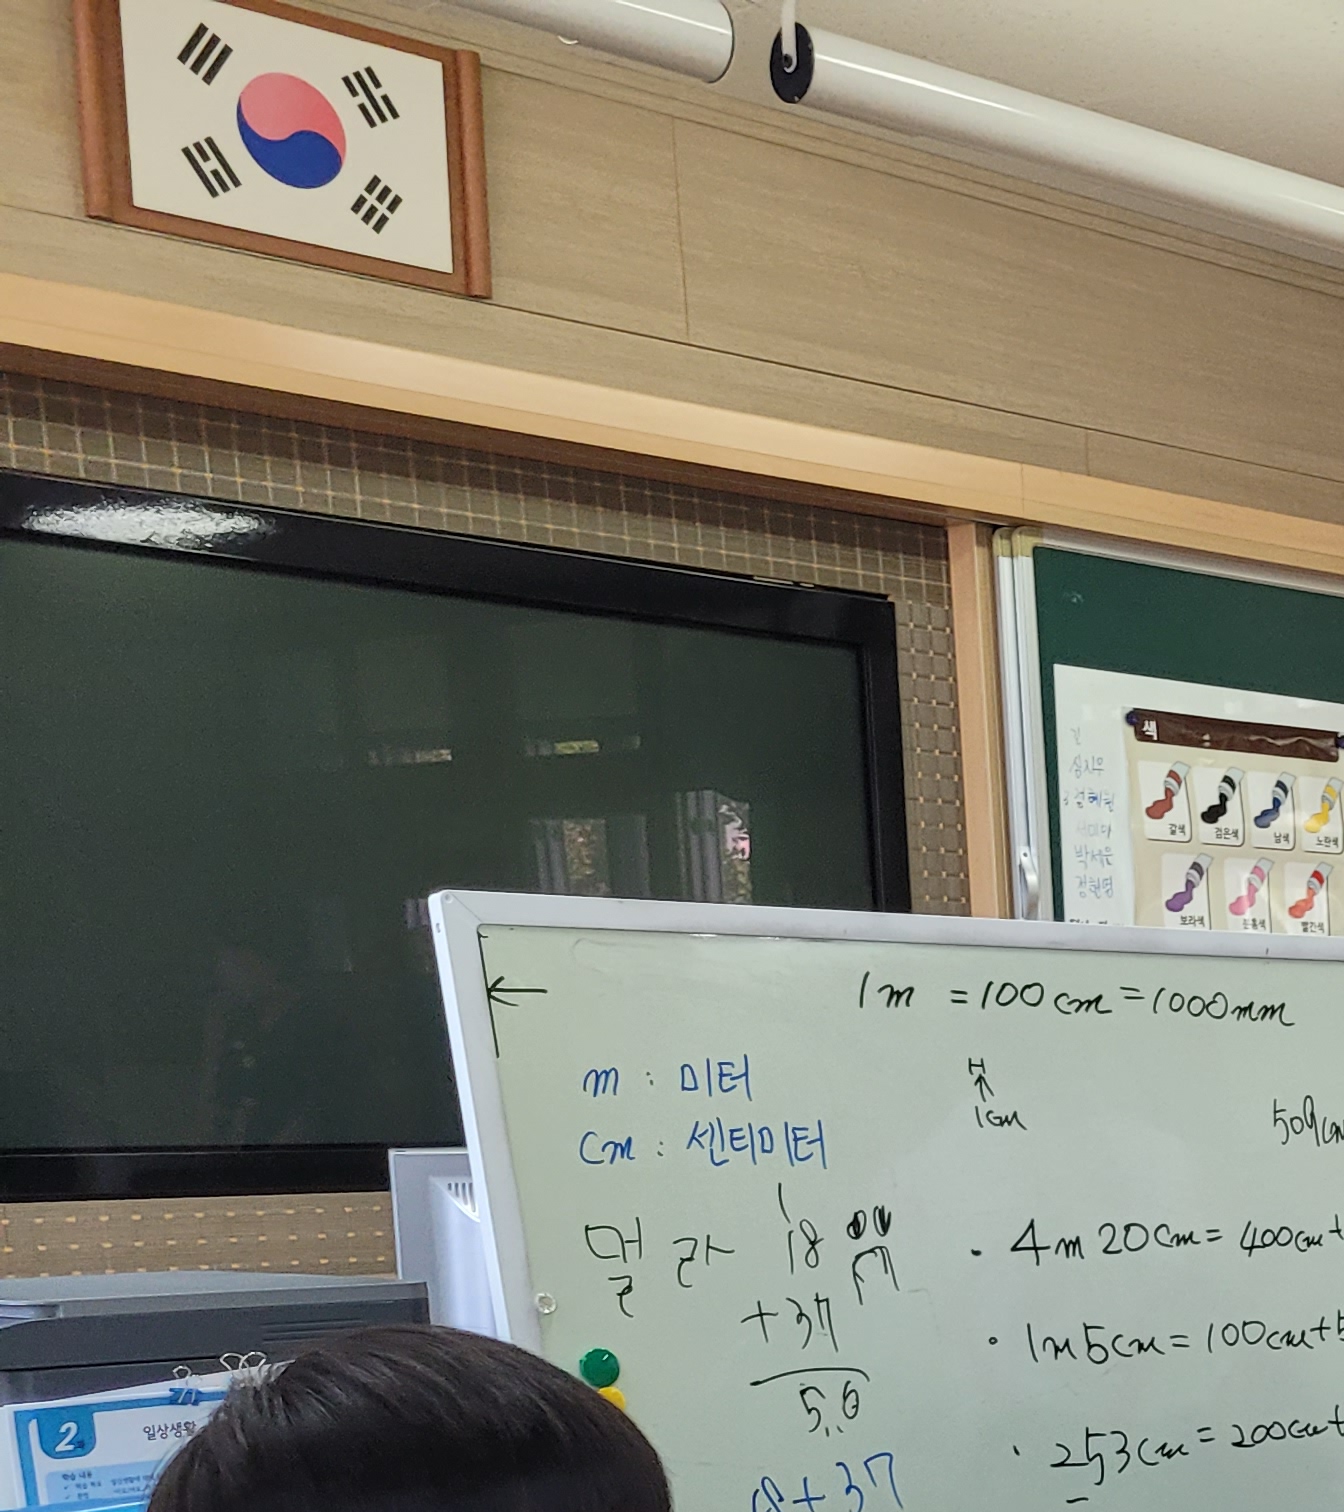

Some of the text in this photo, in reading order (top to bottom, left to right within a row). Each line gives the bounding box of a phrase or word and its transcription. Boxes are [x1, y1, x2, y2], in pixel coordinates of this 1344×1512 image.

[1142, 720, 1158, 741] 색
[1168, 823, 1186, 836] 갈색
[1214, 827, 1239, 841] 검은색
[1274, 832, 1290, 845] 남색
[1316, 836, 1339, 849] 노란색
[1180, 915, 1205, 928] 보라색
[1300, 921, 1325, 934] 빨간색
[680, 1053, 753, 1102] 미터
[686, 1116, 828, 1170] 센티미터
